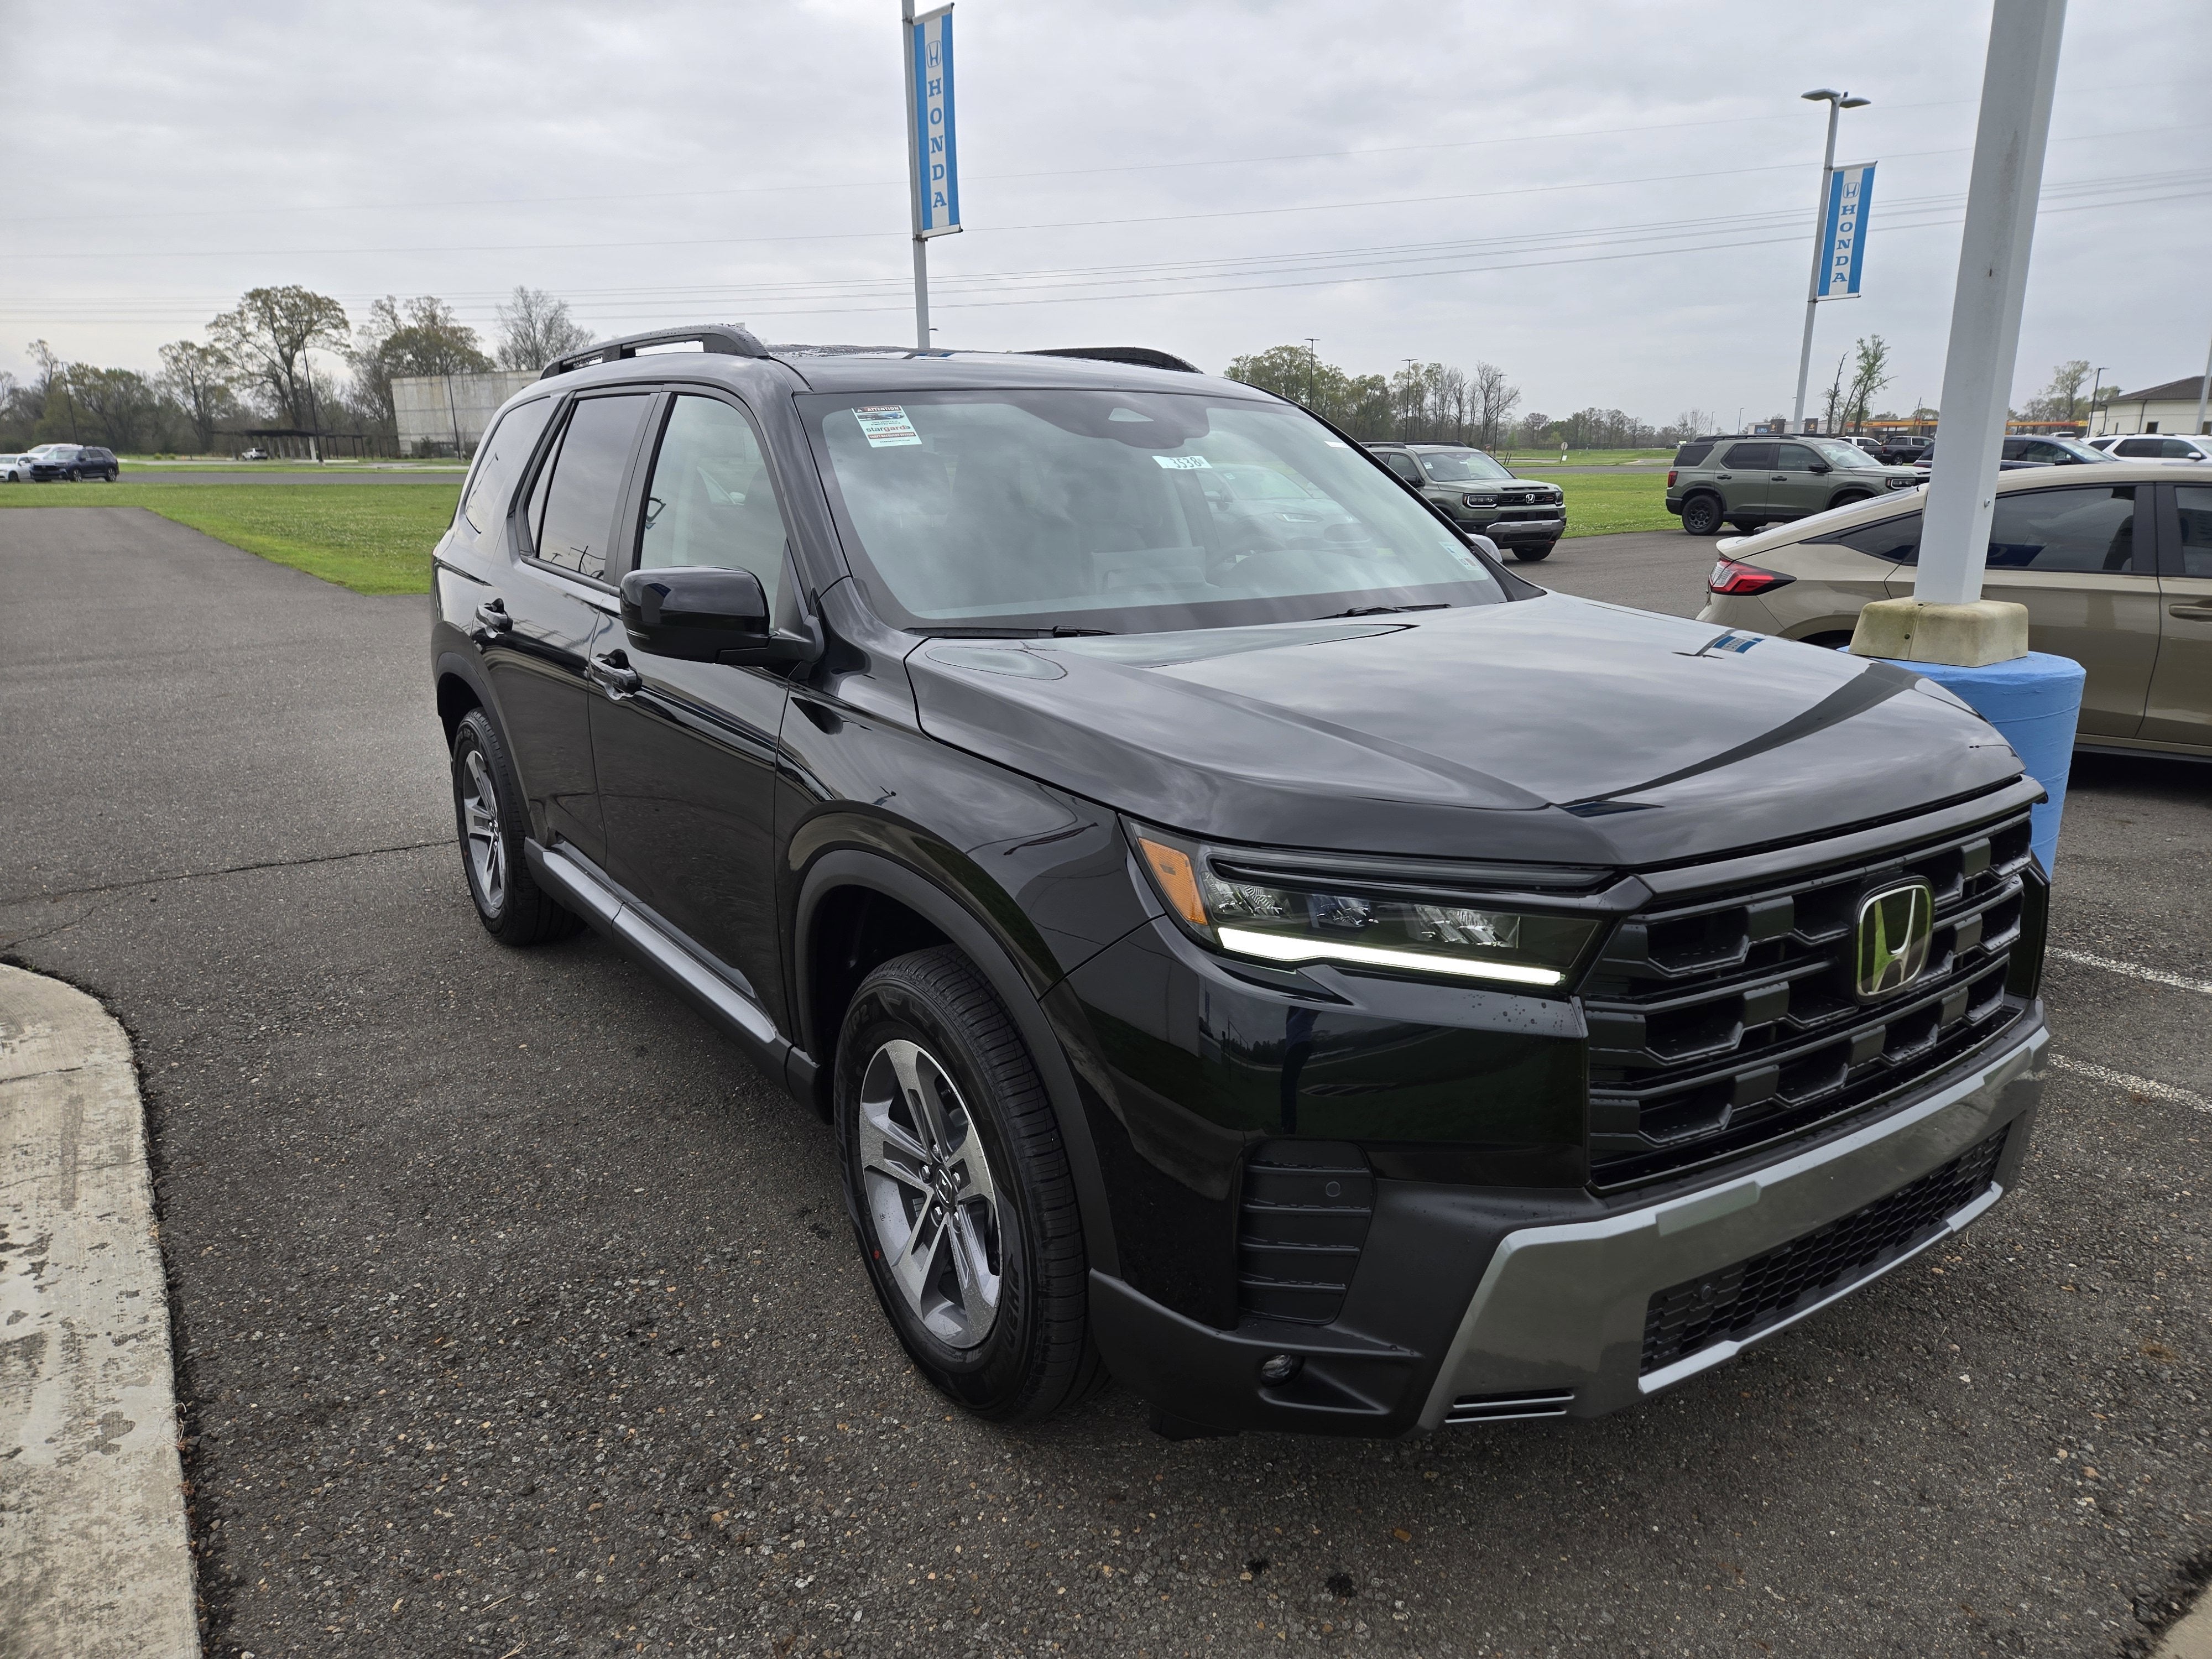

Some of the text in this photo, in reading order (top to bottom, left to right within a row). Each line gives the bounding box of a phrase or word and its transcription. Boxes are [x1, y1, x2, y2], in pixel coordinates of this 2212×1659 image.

[928, 78, 947, 208] HONDA
[1832, 204, 1856, 283] HONDA
[1170, 457, 1202, 468] 3538
